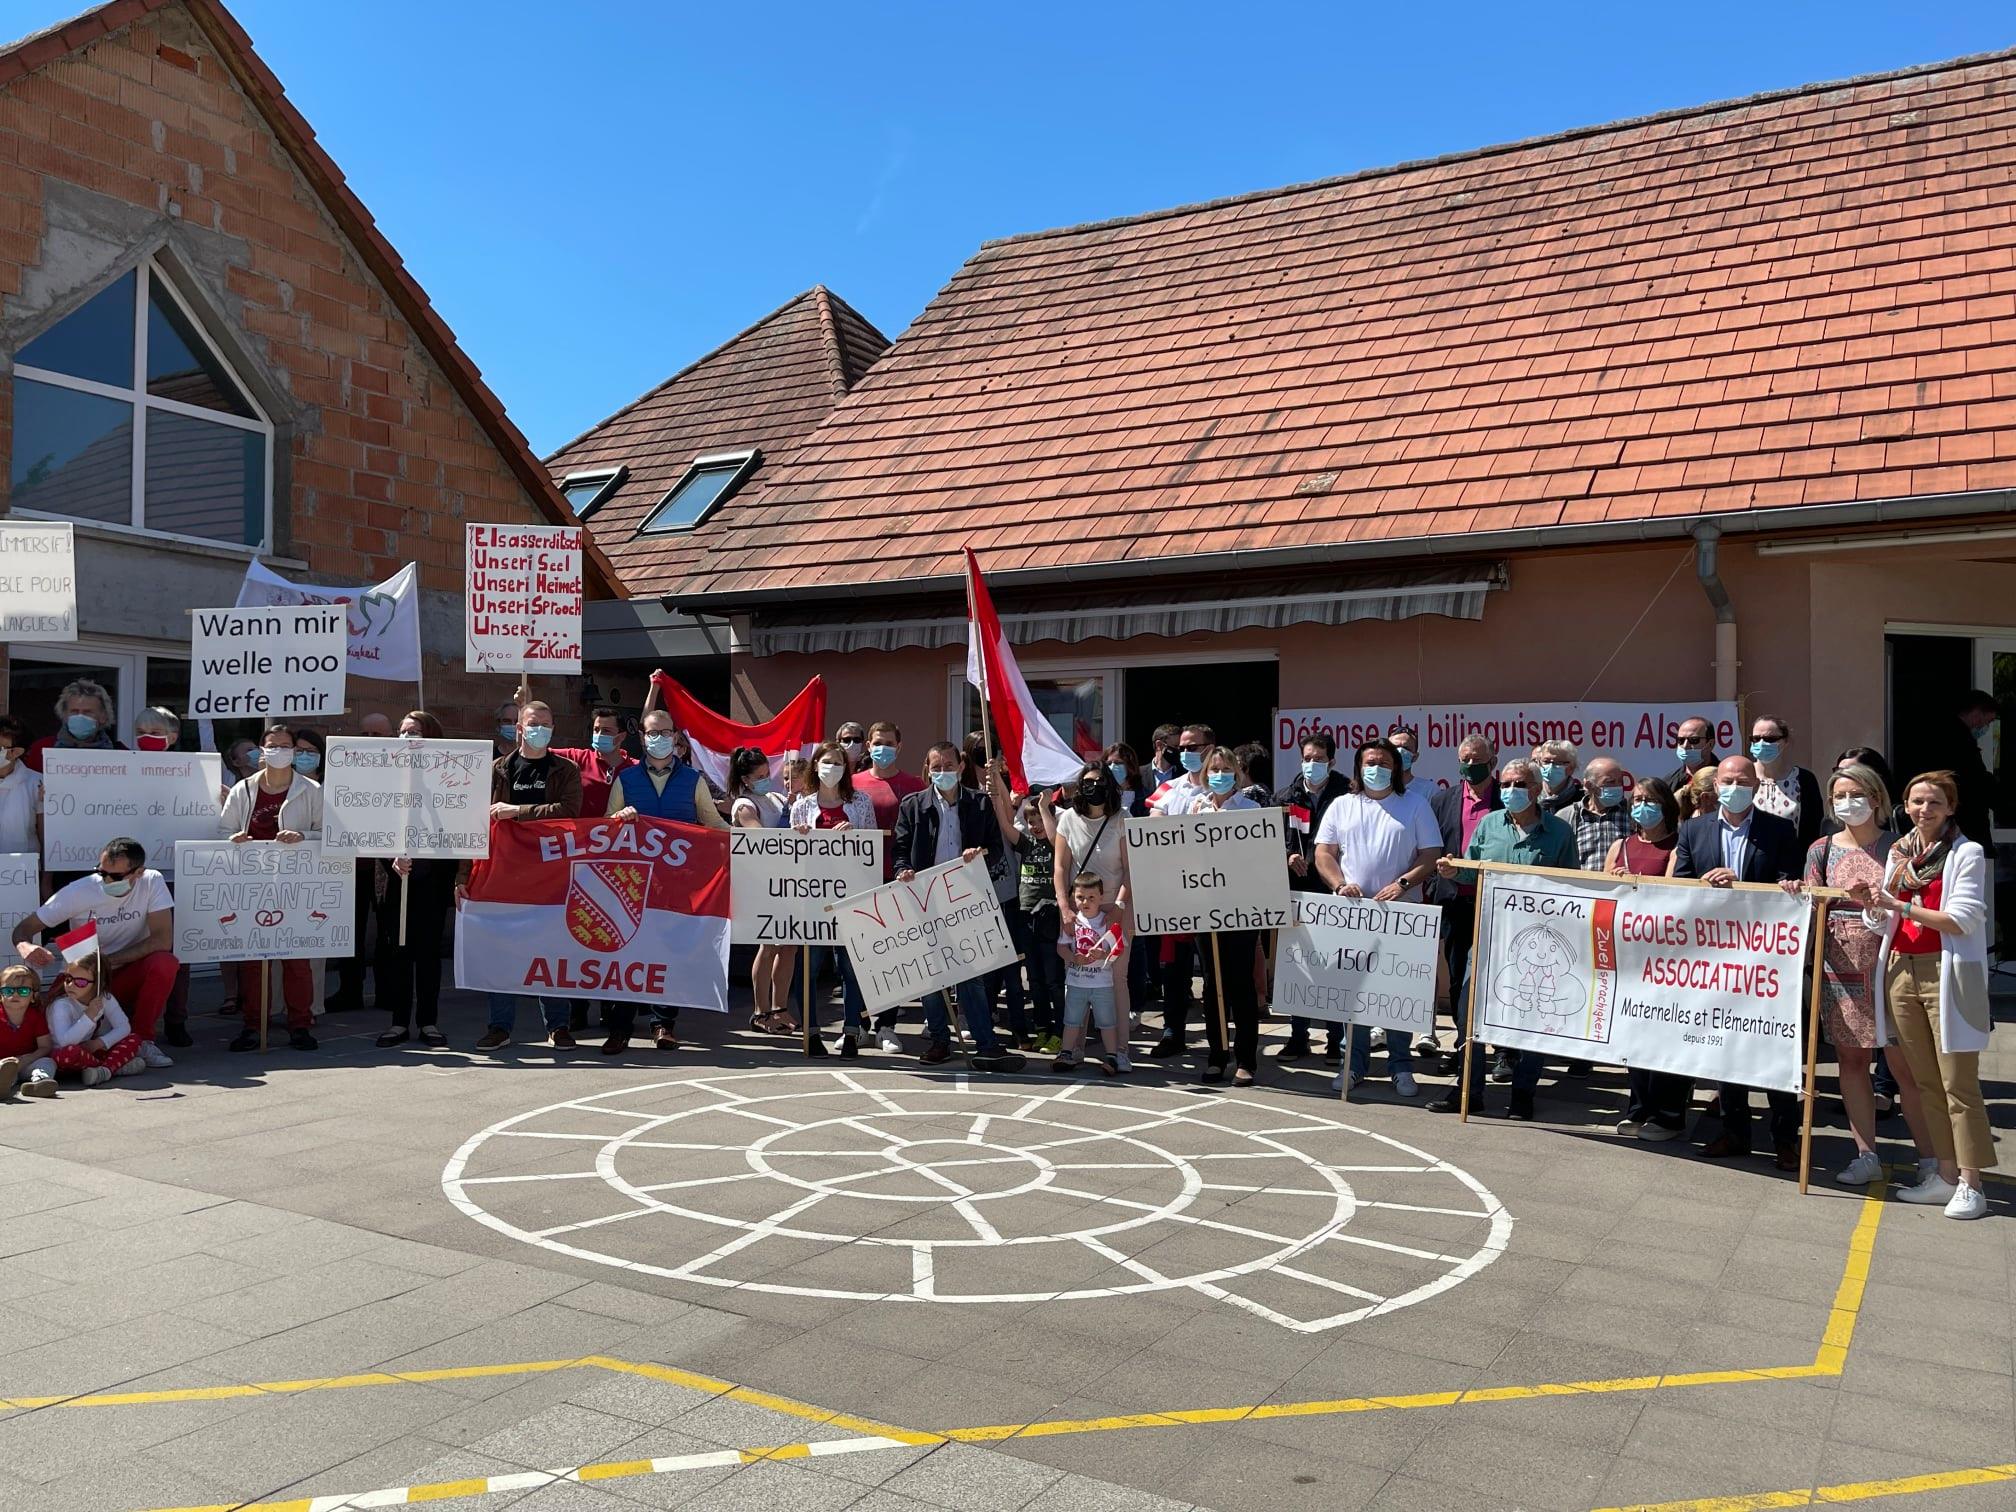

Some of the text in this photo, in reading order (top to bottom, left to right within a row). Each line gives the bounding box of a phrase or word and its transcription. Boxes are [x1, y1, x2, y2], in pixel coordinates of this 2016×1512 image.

[474, 549, 569, 571] Unseri Seel
[31, 576, 71, 593] POUR
[473, 572, 582, 594] Unseri Heimet
[472, 593, 528, 614] Unseri
[200, 614, 281, 636] Wann
[295, 610, 339, 634] mir
[202, 651, 338, 675] welle noo
[195, 688, 328, 713] derfe mir
[1428, 712, 1583, 754] bilinguisme
[1592, 720, 1624, 748] en
[1634, 712, 1733, 749] Alse
[45, 757, 192, 777] Enseignement immersif
[46, 793, 216, 817] 50 années de Luttes
[432, 793, 468, 809] DES
[539, 823, 692, 867] ELSASS
[1128, 818, 1276, 848] Unsri Sproch
[49, 840, 100, 863] Assass
[731, 833, 874, 866] Zweisprachig
[318, 860, 352, 874] nos
[1182, 867, 1226, 889] isch
[193, 881, 343, 911] ENFANTS
[769, 878, 846, 898] unsere
[853, 865, 972, 928] VIVE
[1137, 906, 1286, 933] Unser Schàtz
[1291, 900, 1438, 938] LSASSERDITSCH
[1504, 894, 1585, 919] A.B.C.M.
[850, 889, 999, 962] l'enseignement
[1622, 911, 1800, 956] ECOLES BILINGUES
[523, 957, 668, 994] ALSACE
[1285, 947, 1432, 980] SCHON 1500 JOHR
[1642, 957, 1779, 998] ASSOCIATIVES
[1283, 983, 1433, 1024] UNSERI SPROOCH
[1621, 998, 1796, 1039] Maternelles et Elémentaires
[1683, 1032, 1722, 1046] depuis 1991
